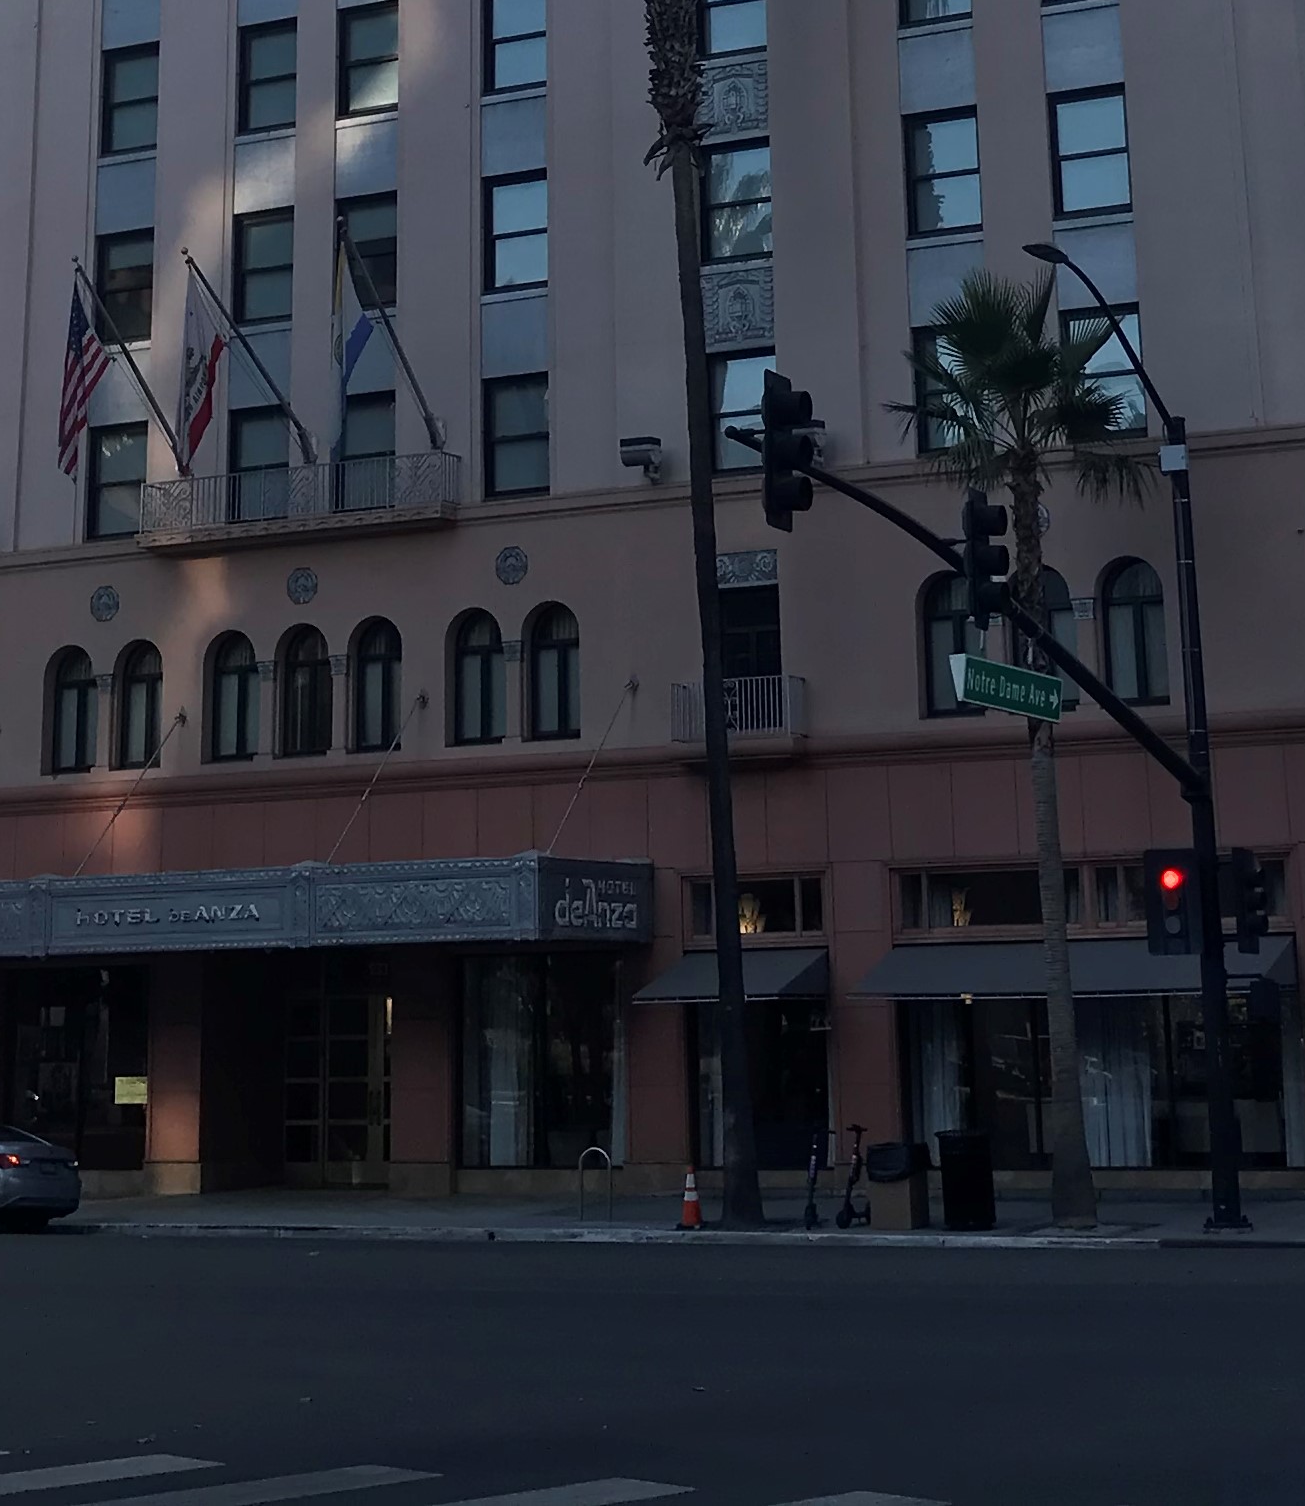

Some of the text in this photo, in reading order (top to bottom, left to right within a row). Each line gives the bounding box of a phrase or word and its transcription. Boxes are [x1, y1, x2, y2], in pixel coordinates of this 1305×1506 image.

[966, 668, 1047, 708] Notre Dame Ave
[597, 879, 636, 895] HOTEL
